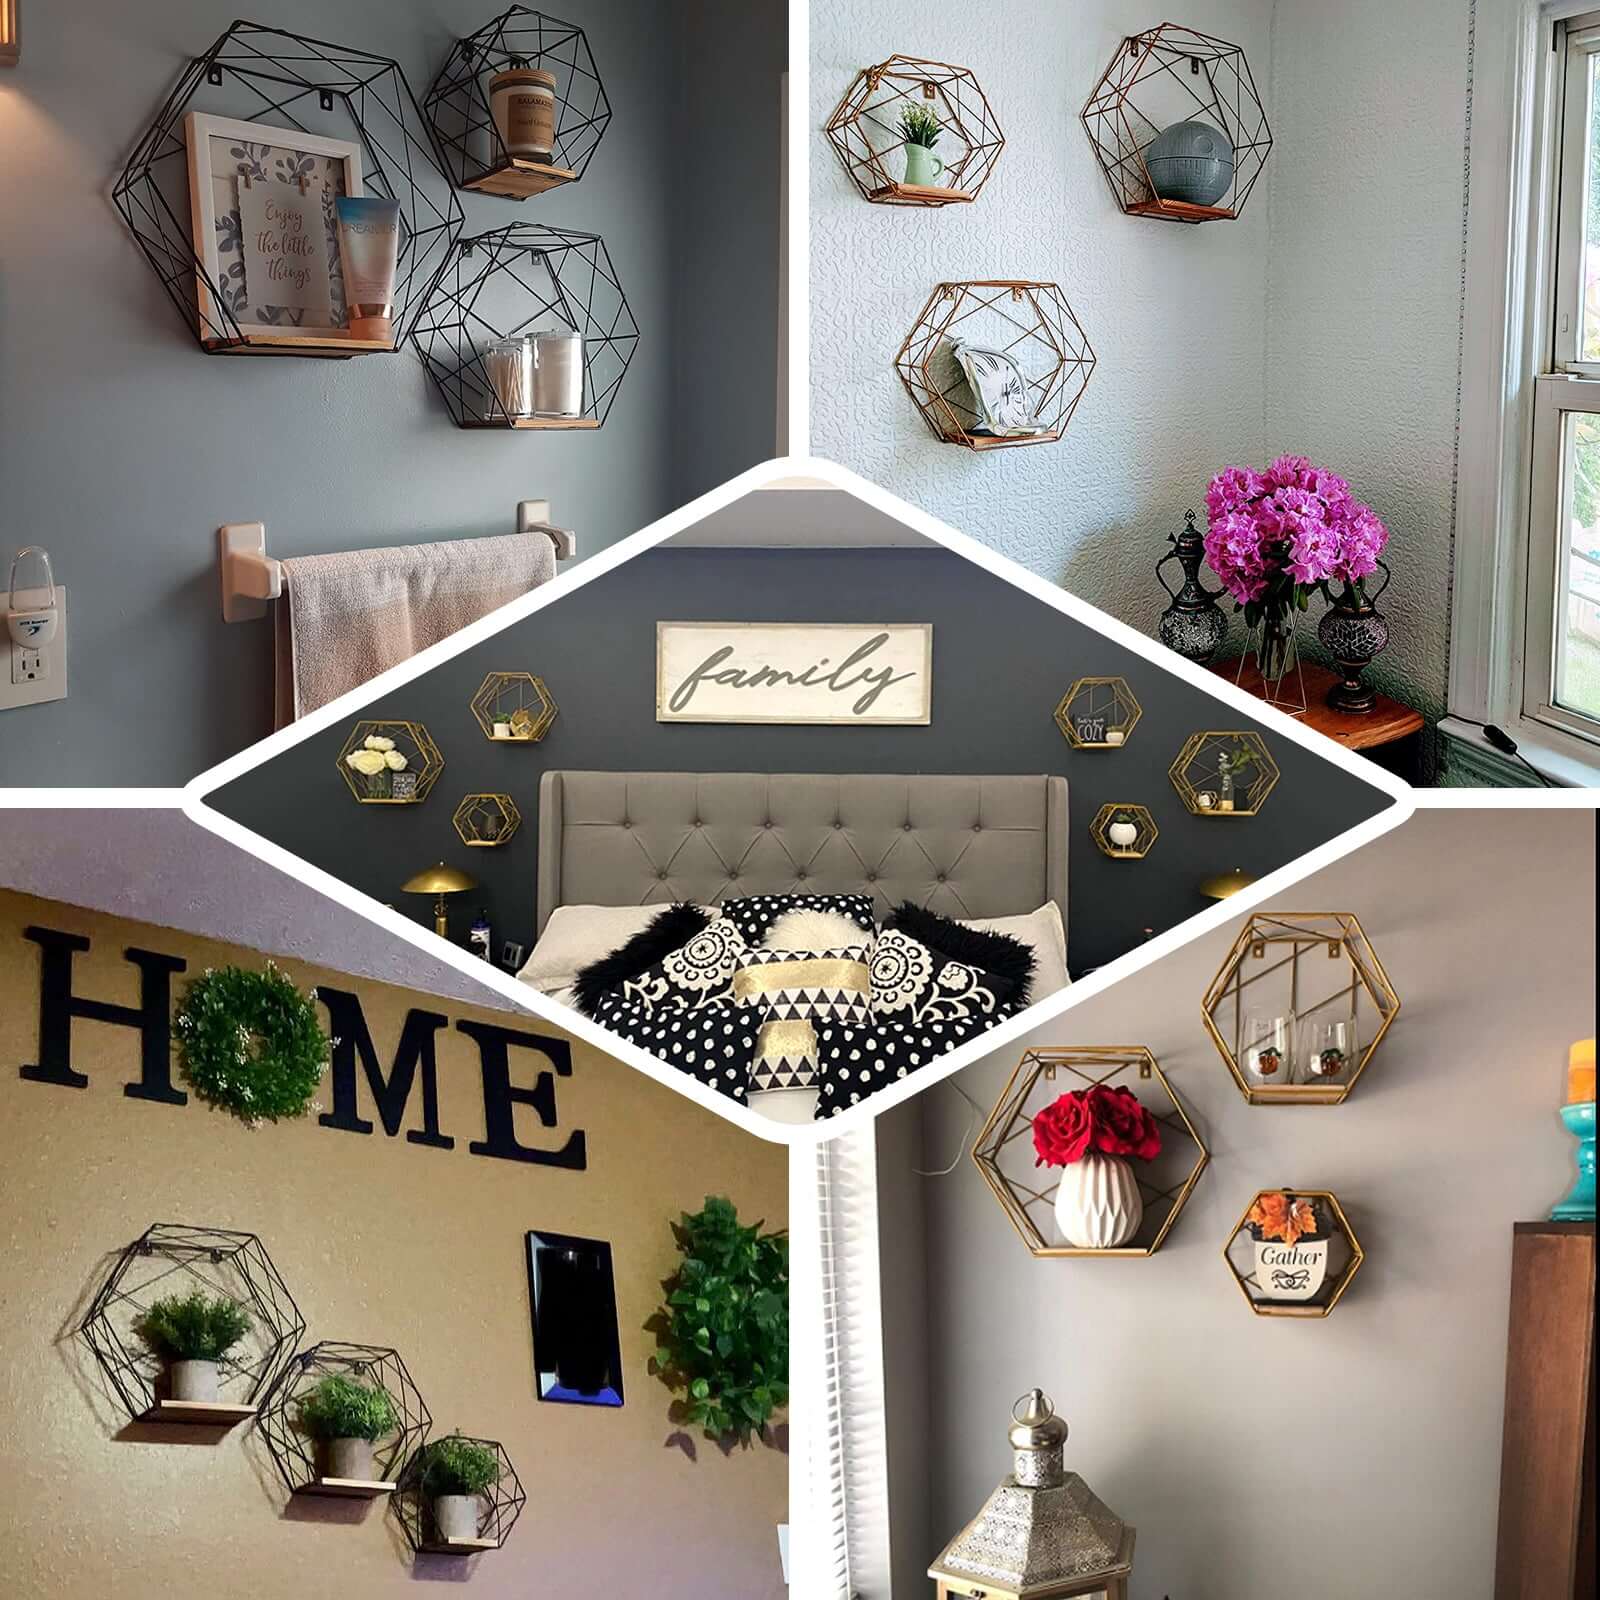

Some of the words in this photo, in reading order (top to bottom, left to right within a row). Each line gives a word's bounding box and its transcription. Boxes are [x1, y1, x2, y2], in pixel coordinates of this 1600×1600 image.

[265, 199, 303, 231] Enjoy
[256, 230, 280, 254] the
[280, 231, 316, 257] little
[265, 257, 312, 289] things
[668, 632, 917, 715] family
[19, 925, 588, 1171] HOME
[1260, 1246, 1323, 1266] Gather
